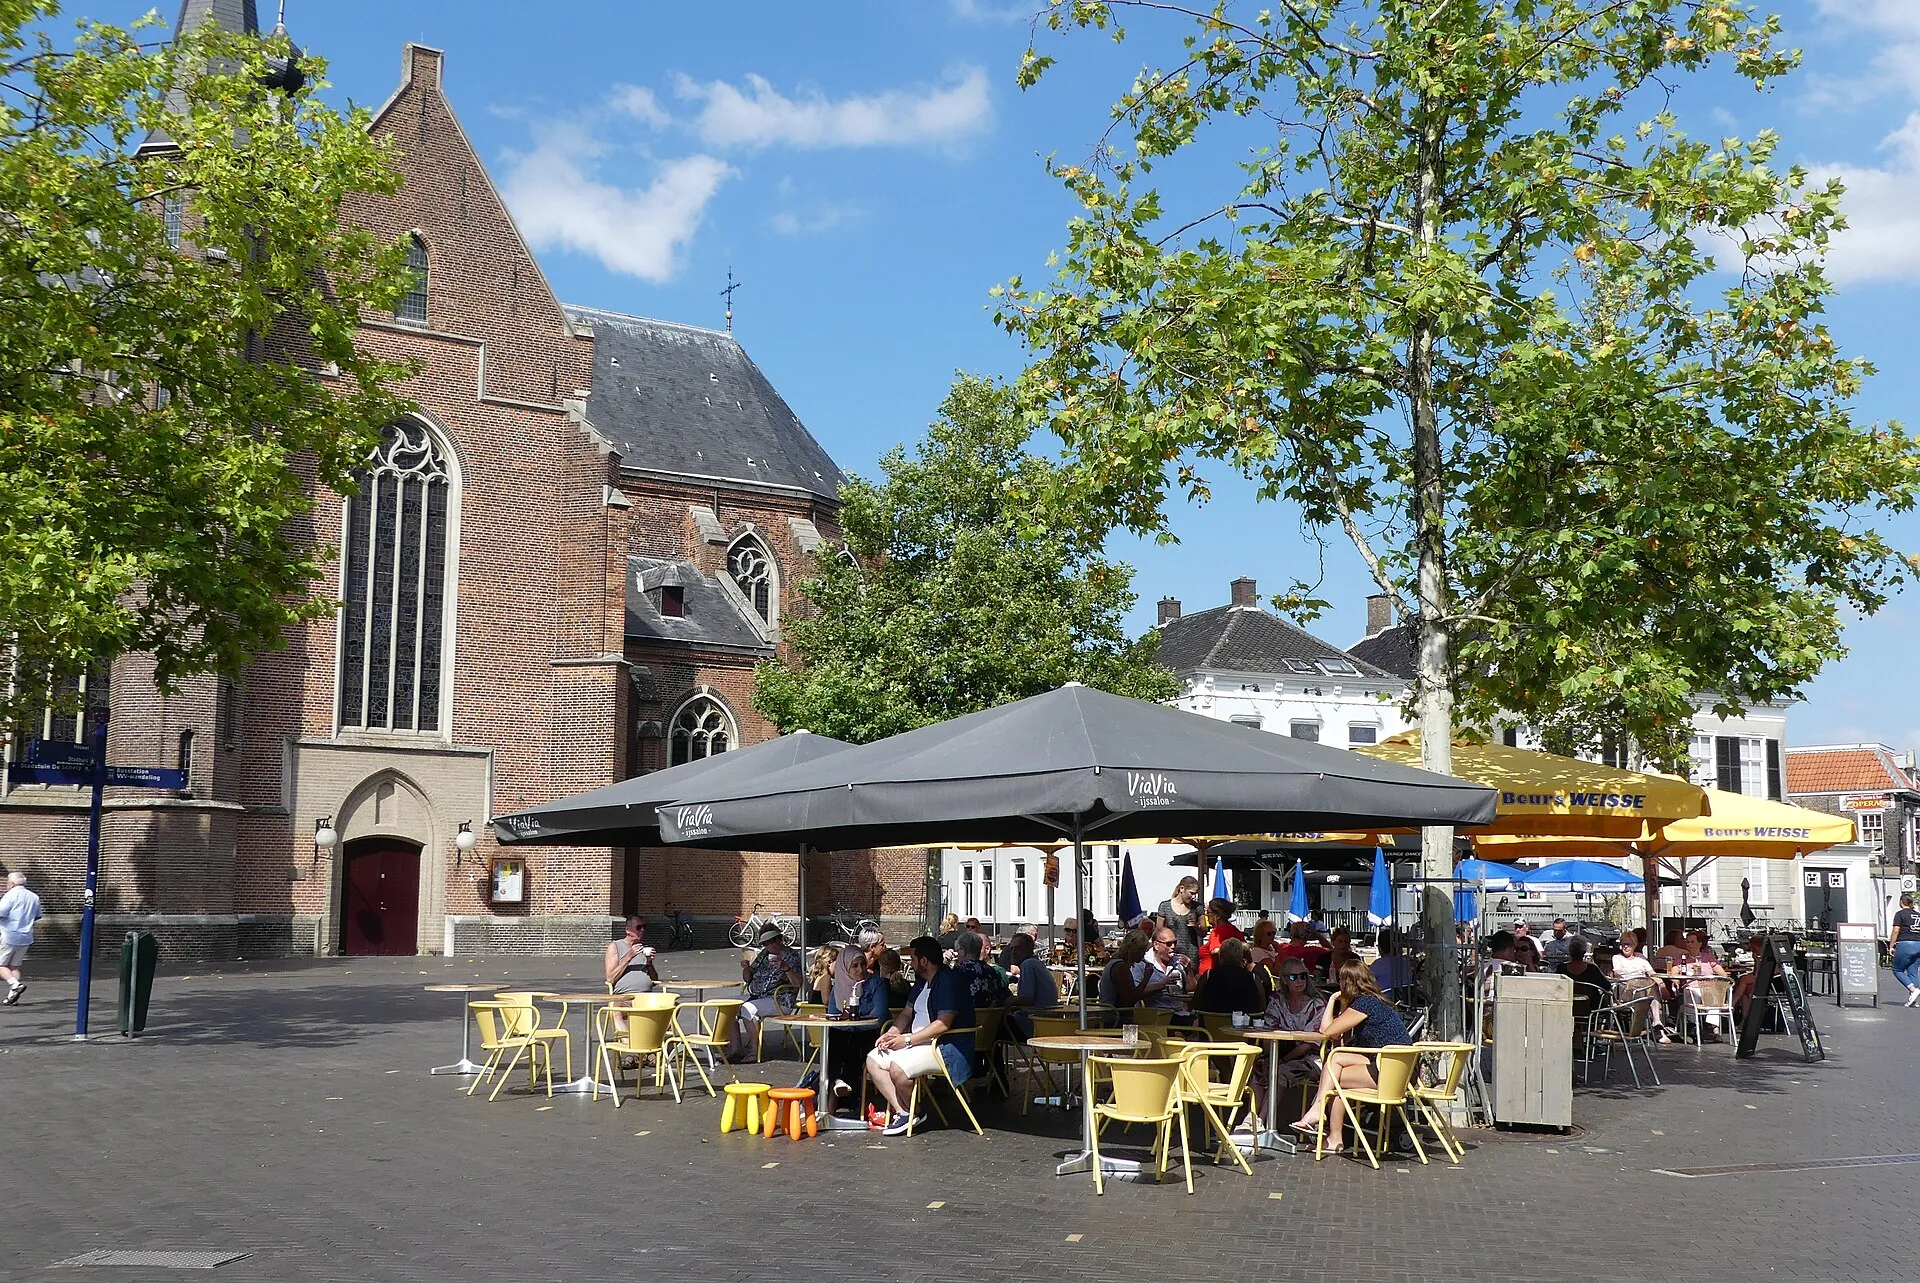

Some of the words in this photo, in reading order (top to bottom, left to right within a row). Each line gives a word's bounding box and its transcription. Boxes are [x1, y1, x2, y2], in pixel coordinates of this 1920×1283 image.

[116, 773, 161, 782] VVV-wandeling
[1127, 771, 1178, 797] ViaVia
[1139, 796, 1170, 809] ijssalon
[1569, 792, 1647, 809] WEISSE
[509, 815, 541, 831] ViaVia
[677, 804, 713, 829] ViaVia
[685, 826, 708, 838] ijssalon
[1753, 827, 1811, 839] WEISSE
